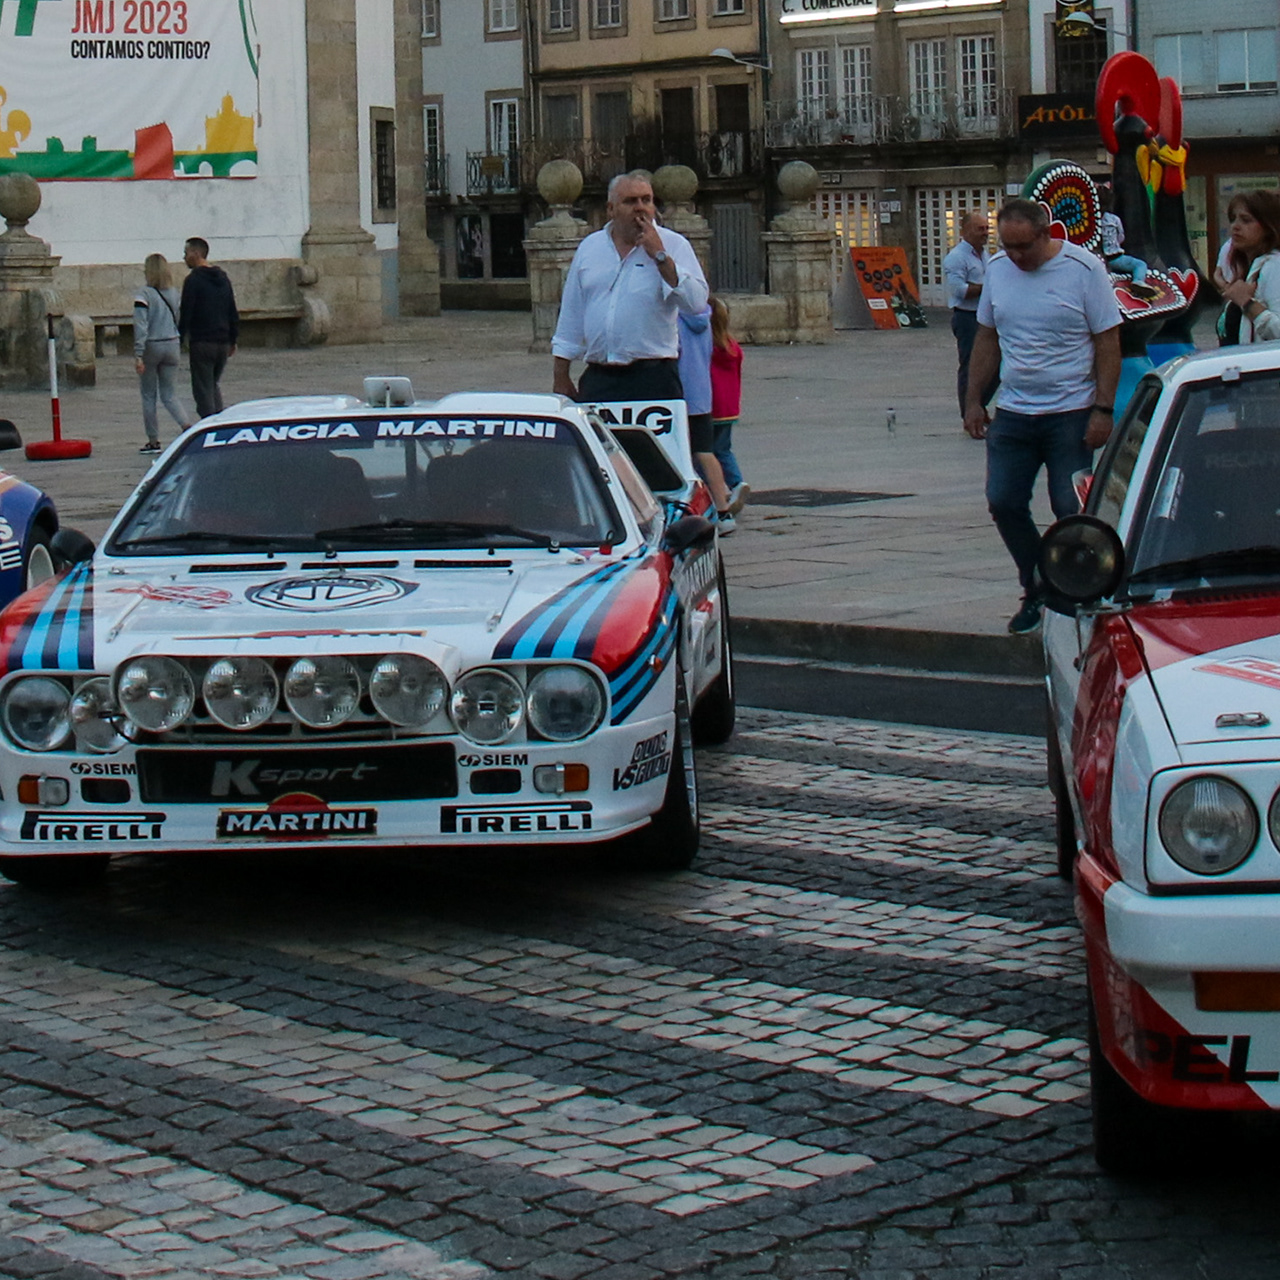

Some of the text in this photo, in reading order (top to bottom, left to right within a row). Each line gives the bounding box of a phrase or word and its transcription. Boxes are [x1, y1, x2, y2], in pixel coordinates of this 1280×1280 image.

[71, 0, 188, 35] JMJ 2023
[71, 40, 211, 59] CONTAMOS CONTIGO?
[202, 420, 557, 449] LANCIA MARTINI
[93, 763, 137, 775] SIEM
[483, 754, 529, 766] SIEM
[21, 811, 167, 841] PIRELLI
[226, 811, 368, 832] MARTINI
[441, 801, 593, 834] PIRELLI
[1134, 1030, 1280, 1083] PEL
